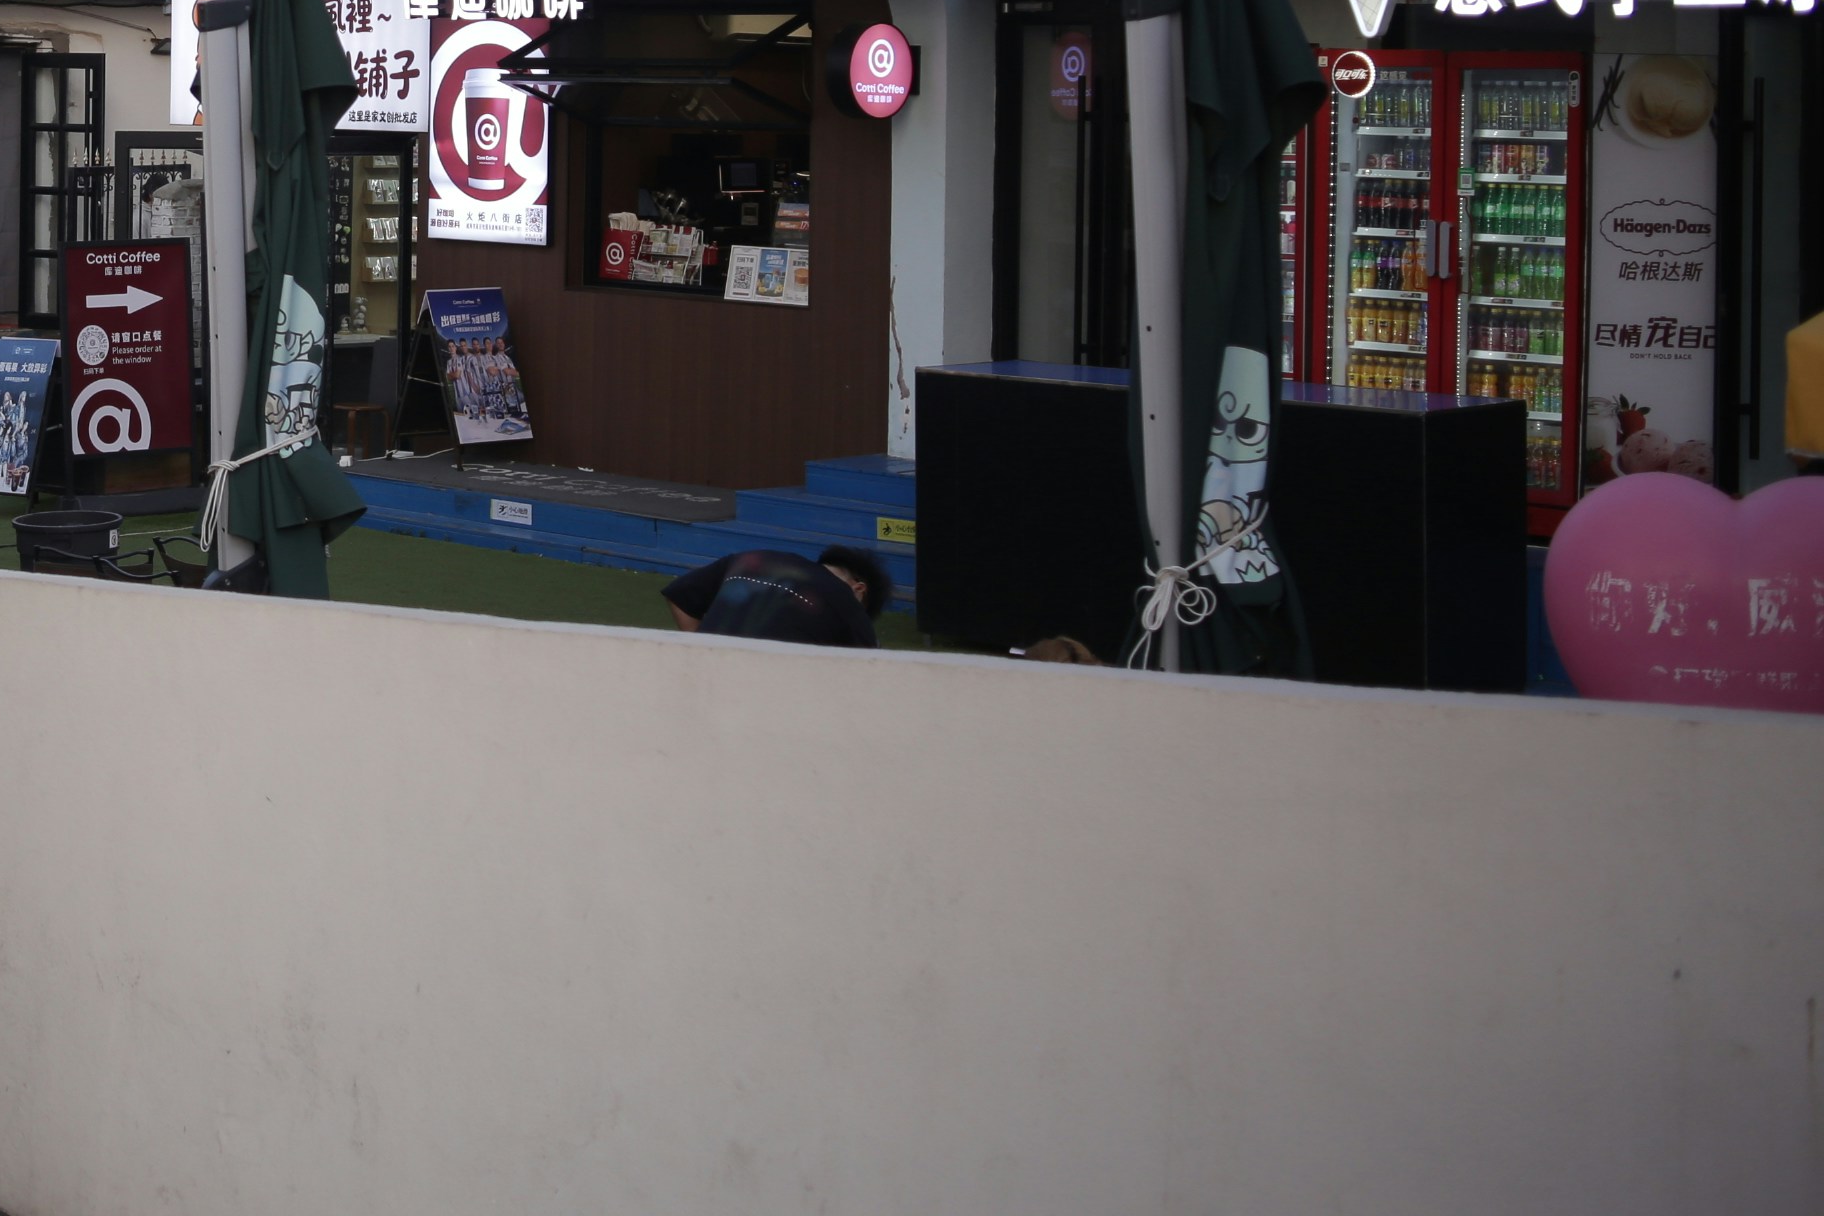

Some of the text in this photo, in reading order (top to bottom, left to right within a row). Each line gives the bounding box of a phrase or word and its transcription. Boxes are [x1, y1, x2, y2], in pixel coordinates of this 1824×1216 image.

[346, 48, 420, 100] 铺子
[856, 82, 905, 94] Cotti Coffee
[1613, 218, 1711, 237] Häagen-Dazs
[86, 251, 161, 264] Cotti Coffee
[1619, 261, 1704, 282] 哈根达斯
[111, 330, 162, 343] 请窗口点餐
[112, 346, 134, 354] Please
[135, 345, 153, 353] order
[125, 356, 152, 364] window
